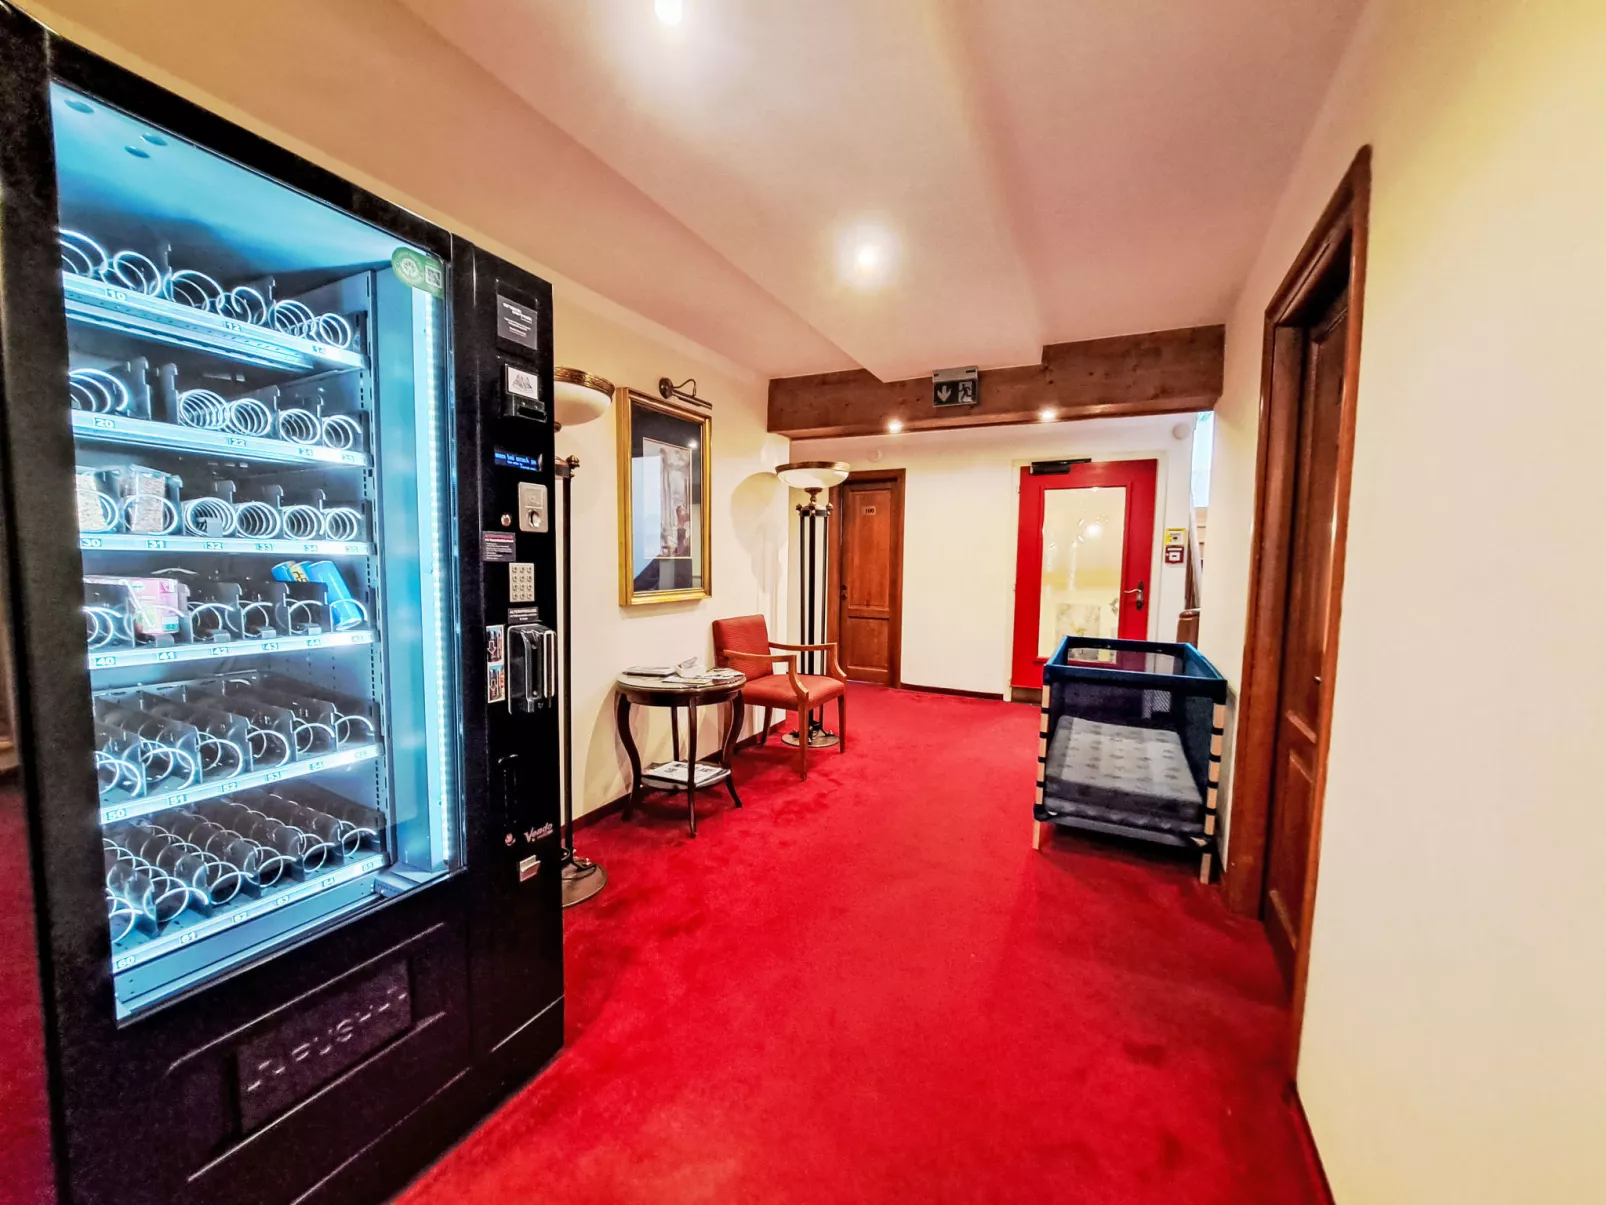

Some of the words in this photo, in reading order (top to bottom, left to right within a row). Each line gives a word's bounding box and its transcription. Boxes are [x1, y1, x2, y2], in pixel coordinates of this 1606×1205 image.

[109, 288, 126, 300] 10
[227, 321, 242, 332] 12
[96, 418, 116, 428] 20
[80, 538, 102, 548] 30
[147, 540, 166, 549] 31
[207, 541, 223, 550] 32
[96, 656, 116, 667] 40
[158, 651, 177, 661] 41
[106, 808, 127, 821] 50
[168, 794, 186, 806] 51
[222, 782, 238, 792] 52
[524, 822, 554, 843] Vendo
[116, 955, 137, 969] 60
[180, 932, 198, 945] 61
